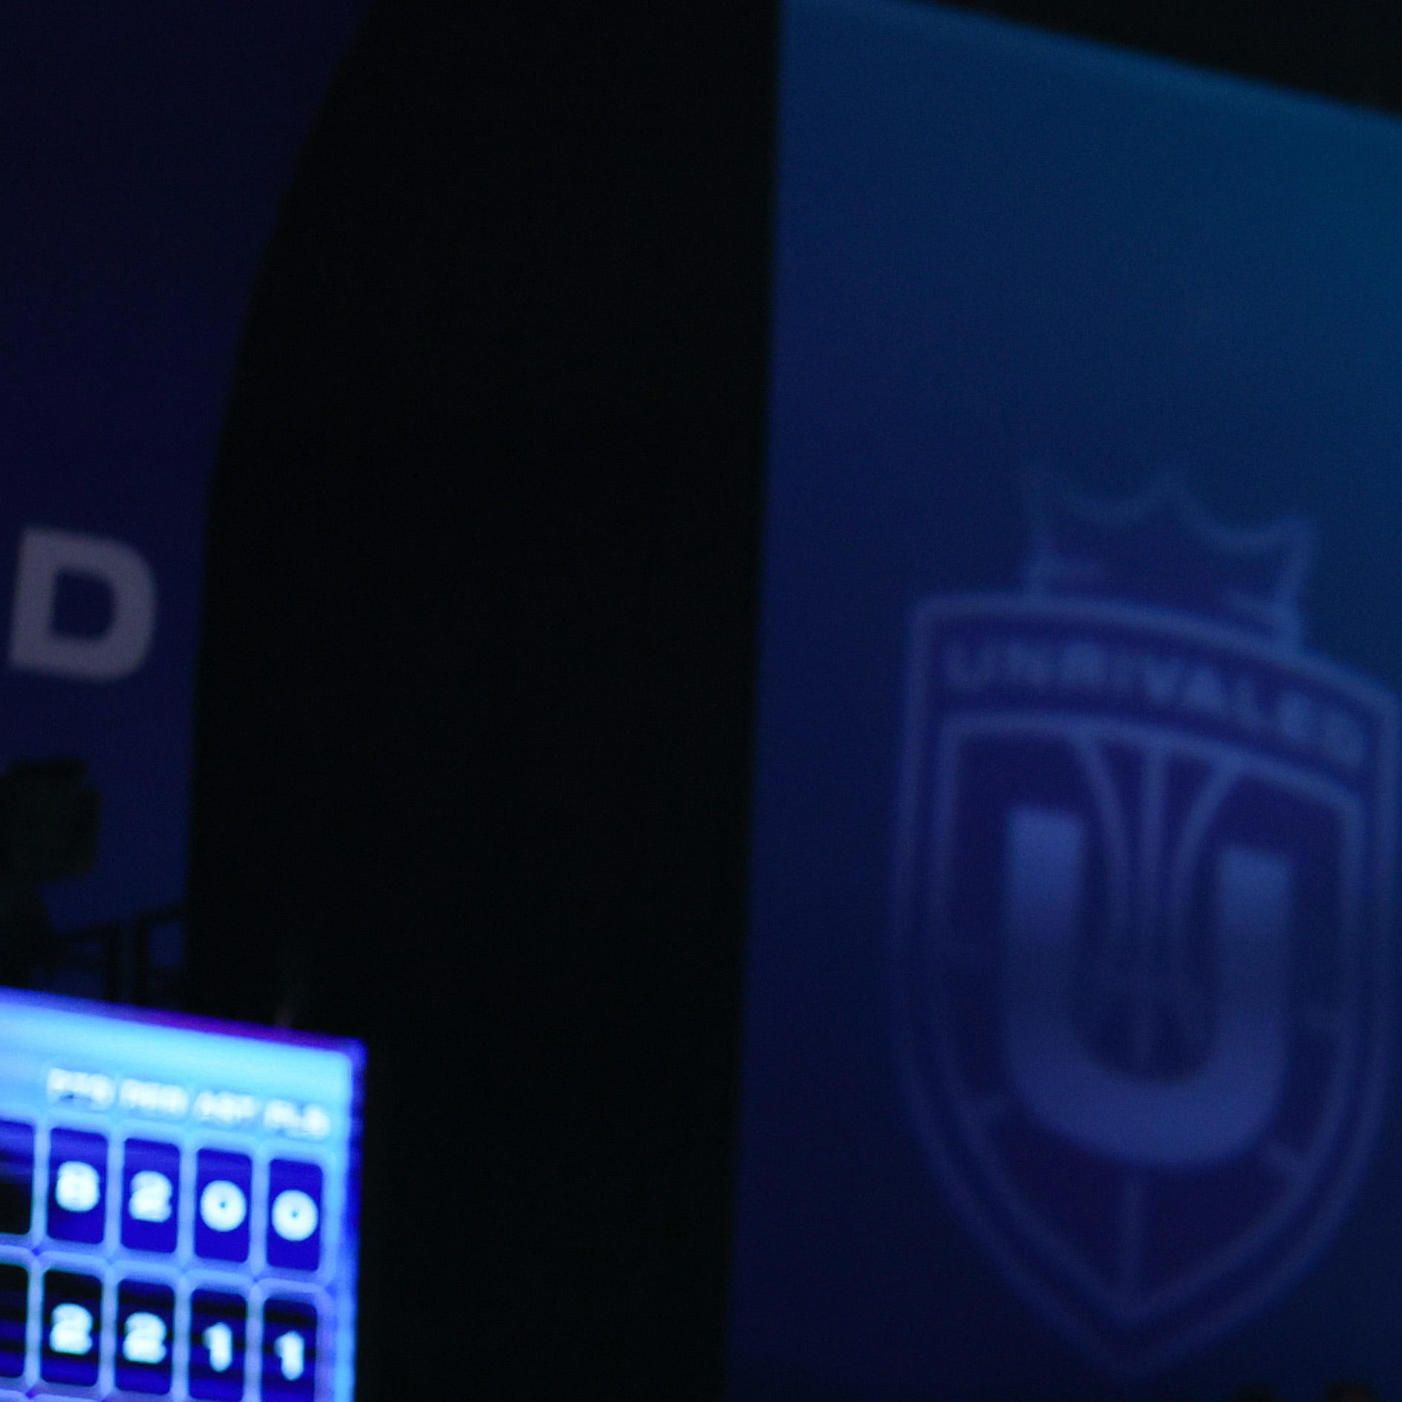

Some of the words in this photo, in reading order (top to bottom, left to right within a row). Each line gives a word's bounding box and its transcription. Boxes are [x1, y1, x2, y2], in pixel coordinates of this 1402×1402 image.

[129, 1170, 173, 1223] 2
[200, 1179, 247, 1232] 0
[271, 1189, 319, 1242] 0
[50, 1303, 93, 1356] 2
[122, 1311, 167, 1364] 2
[203, 1322, 233, 1373] 1
[274, 1331, 305, 1381] 1
